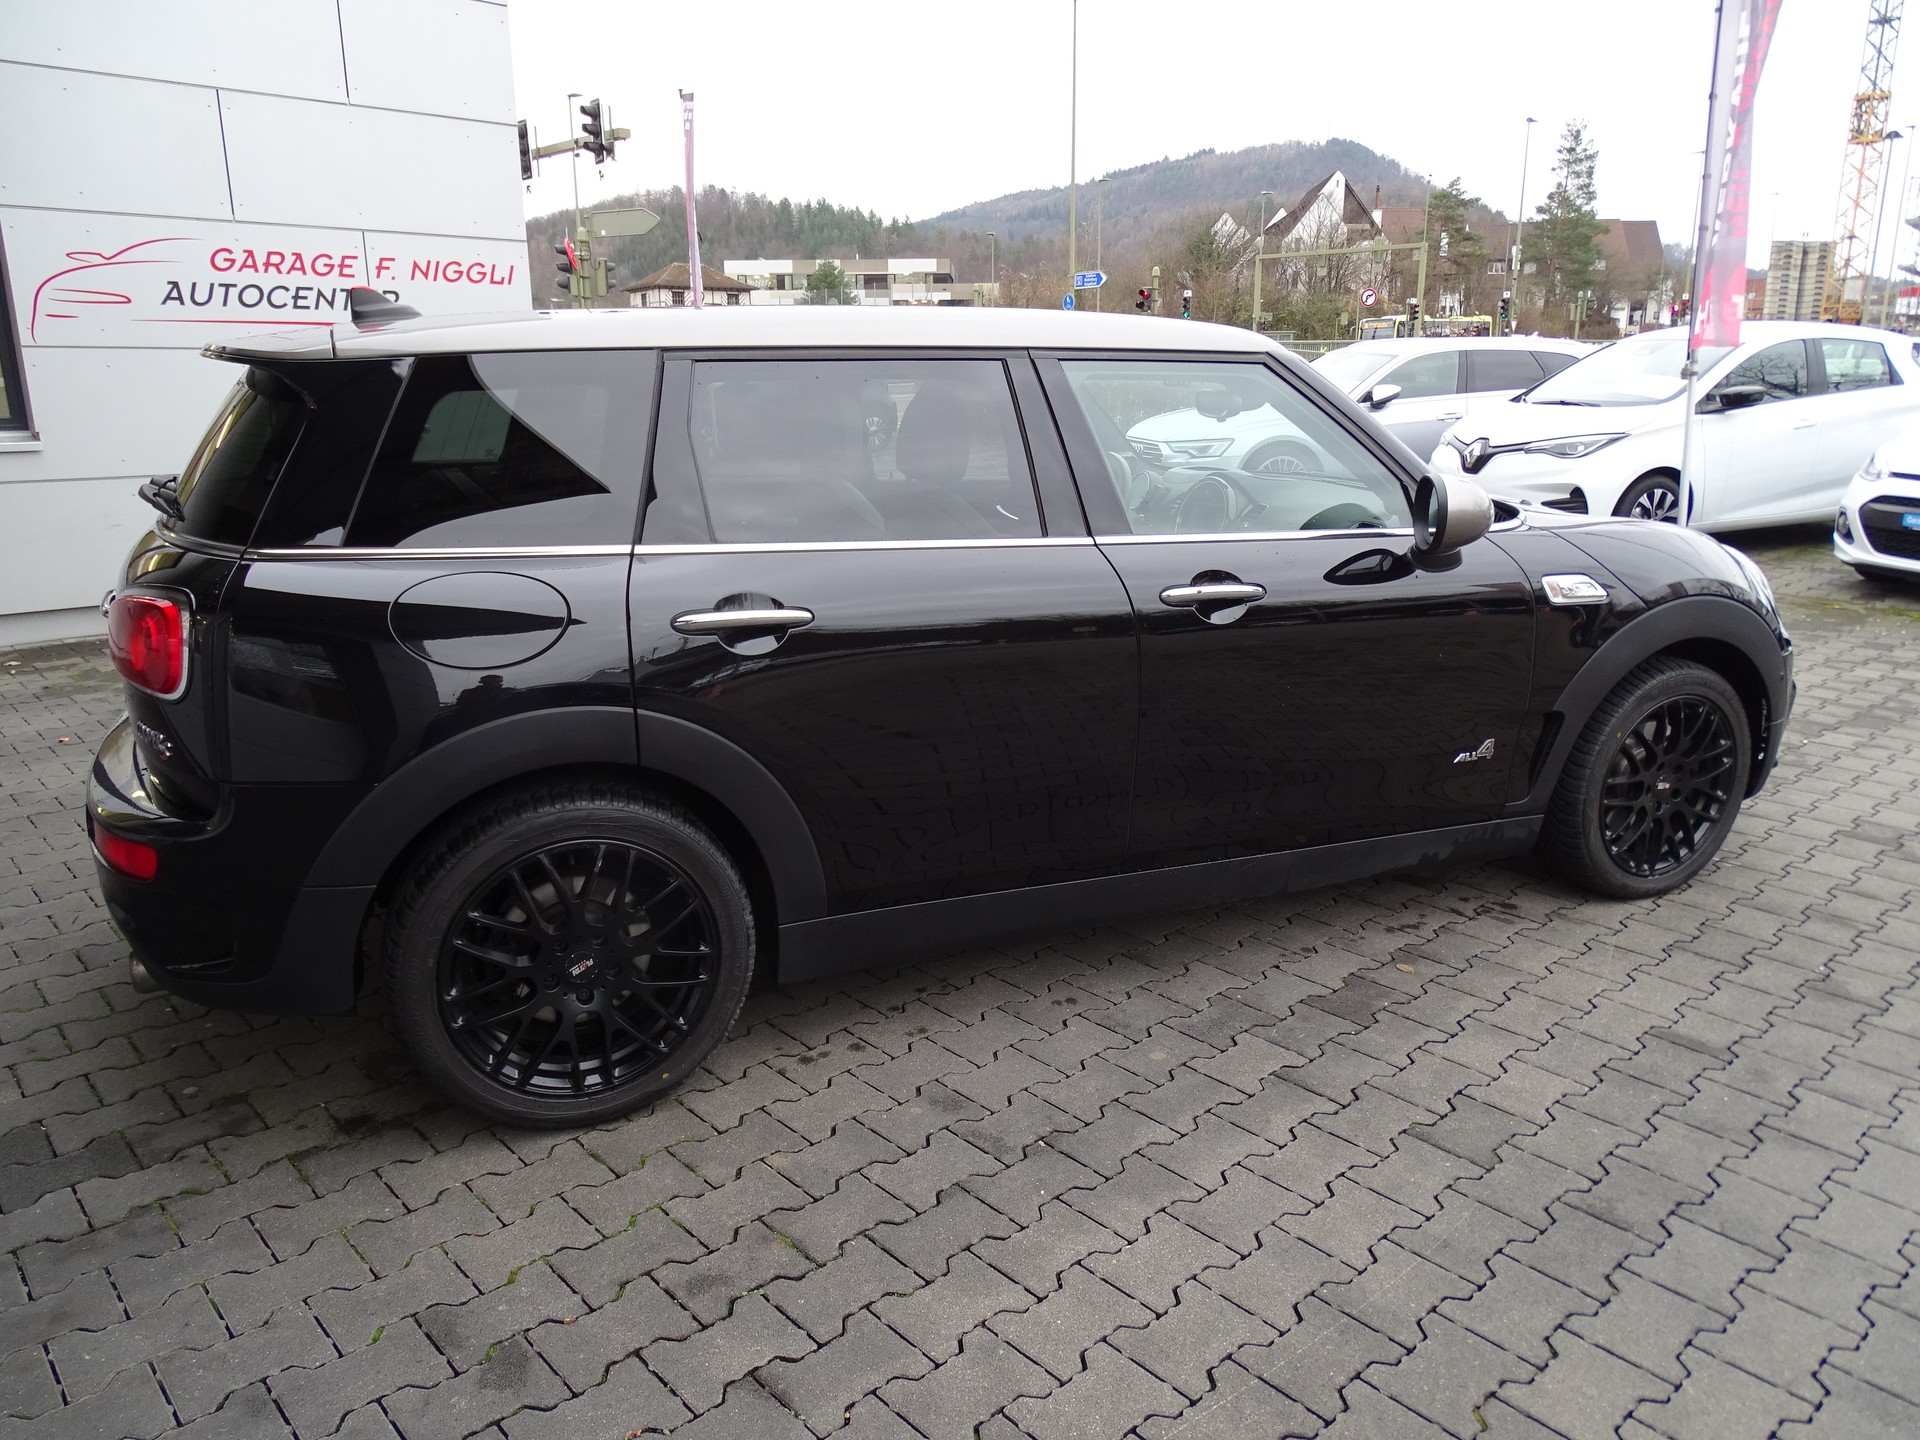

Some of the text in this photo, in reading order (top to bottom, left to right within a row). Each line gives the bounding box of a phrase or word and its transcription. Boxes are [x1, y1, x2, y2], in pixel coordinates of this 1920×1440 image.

[209, 247, 515, 286] GARAGE F. NIGGLI
[160, 280, 400, 312] AUTOCENT
